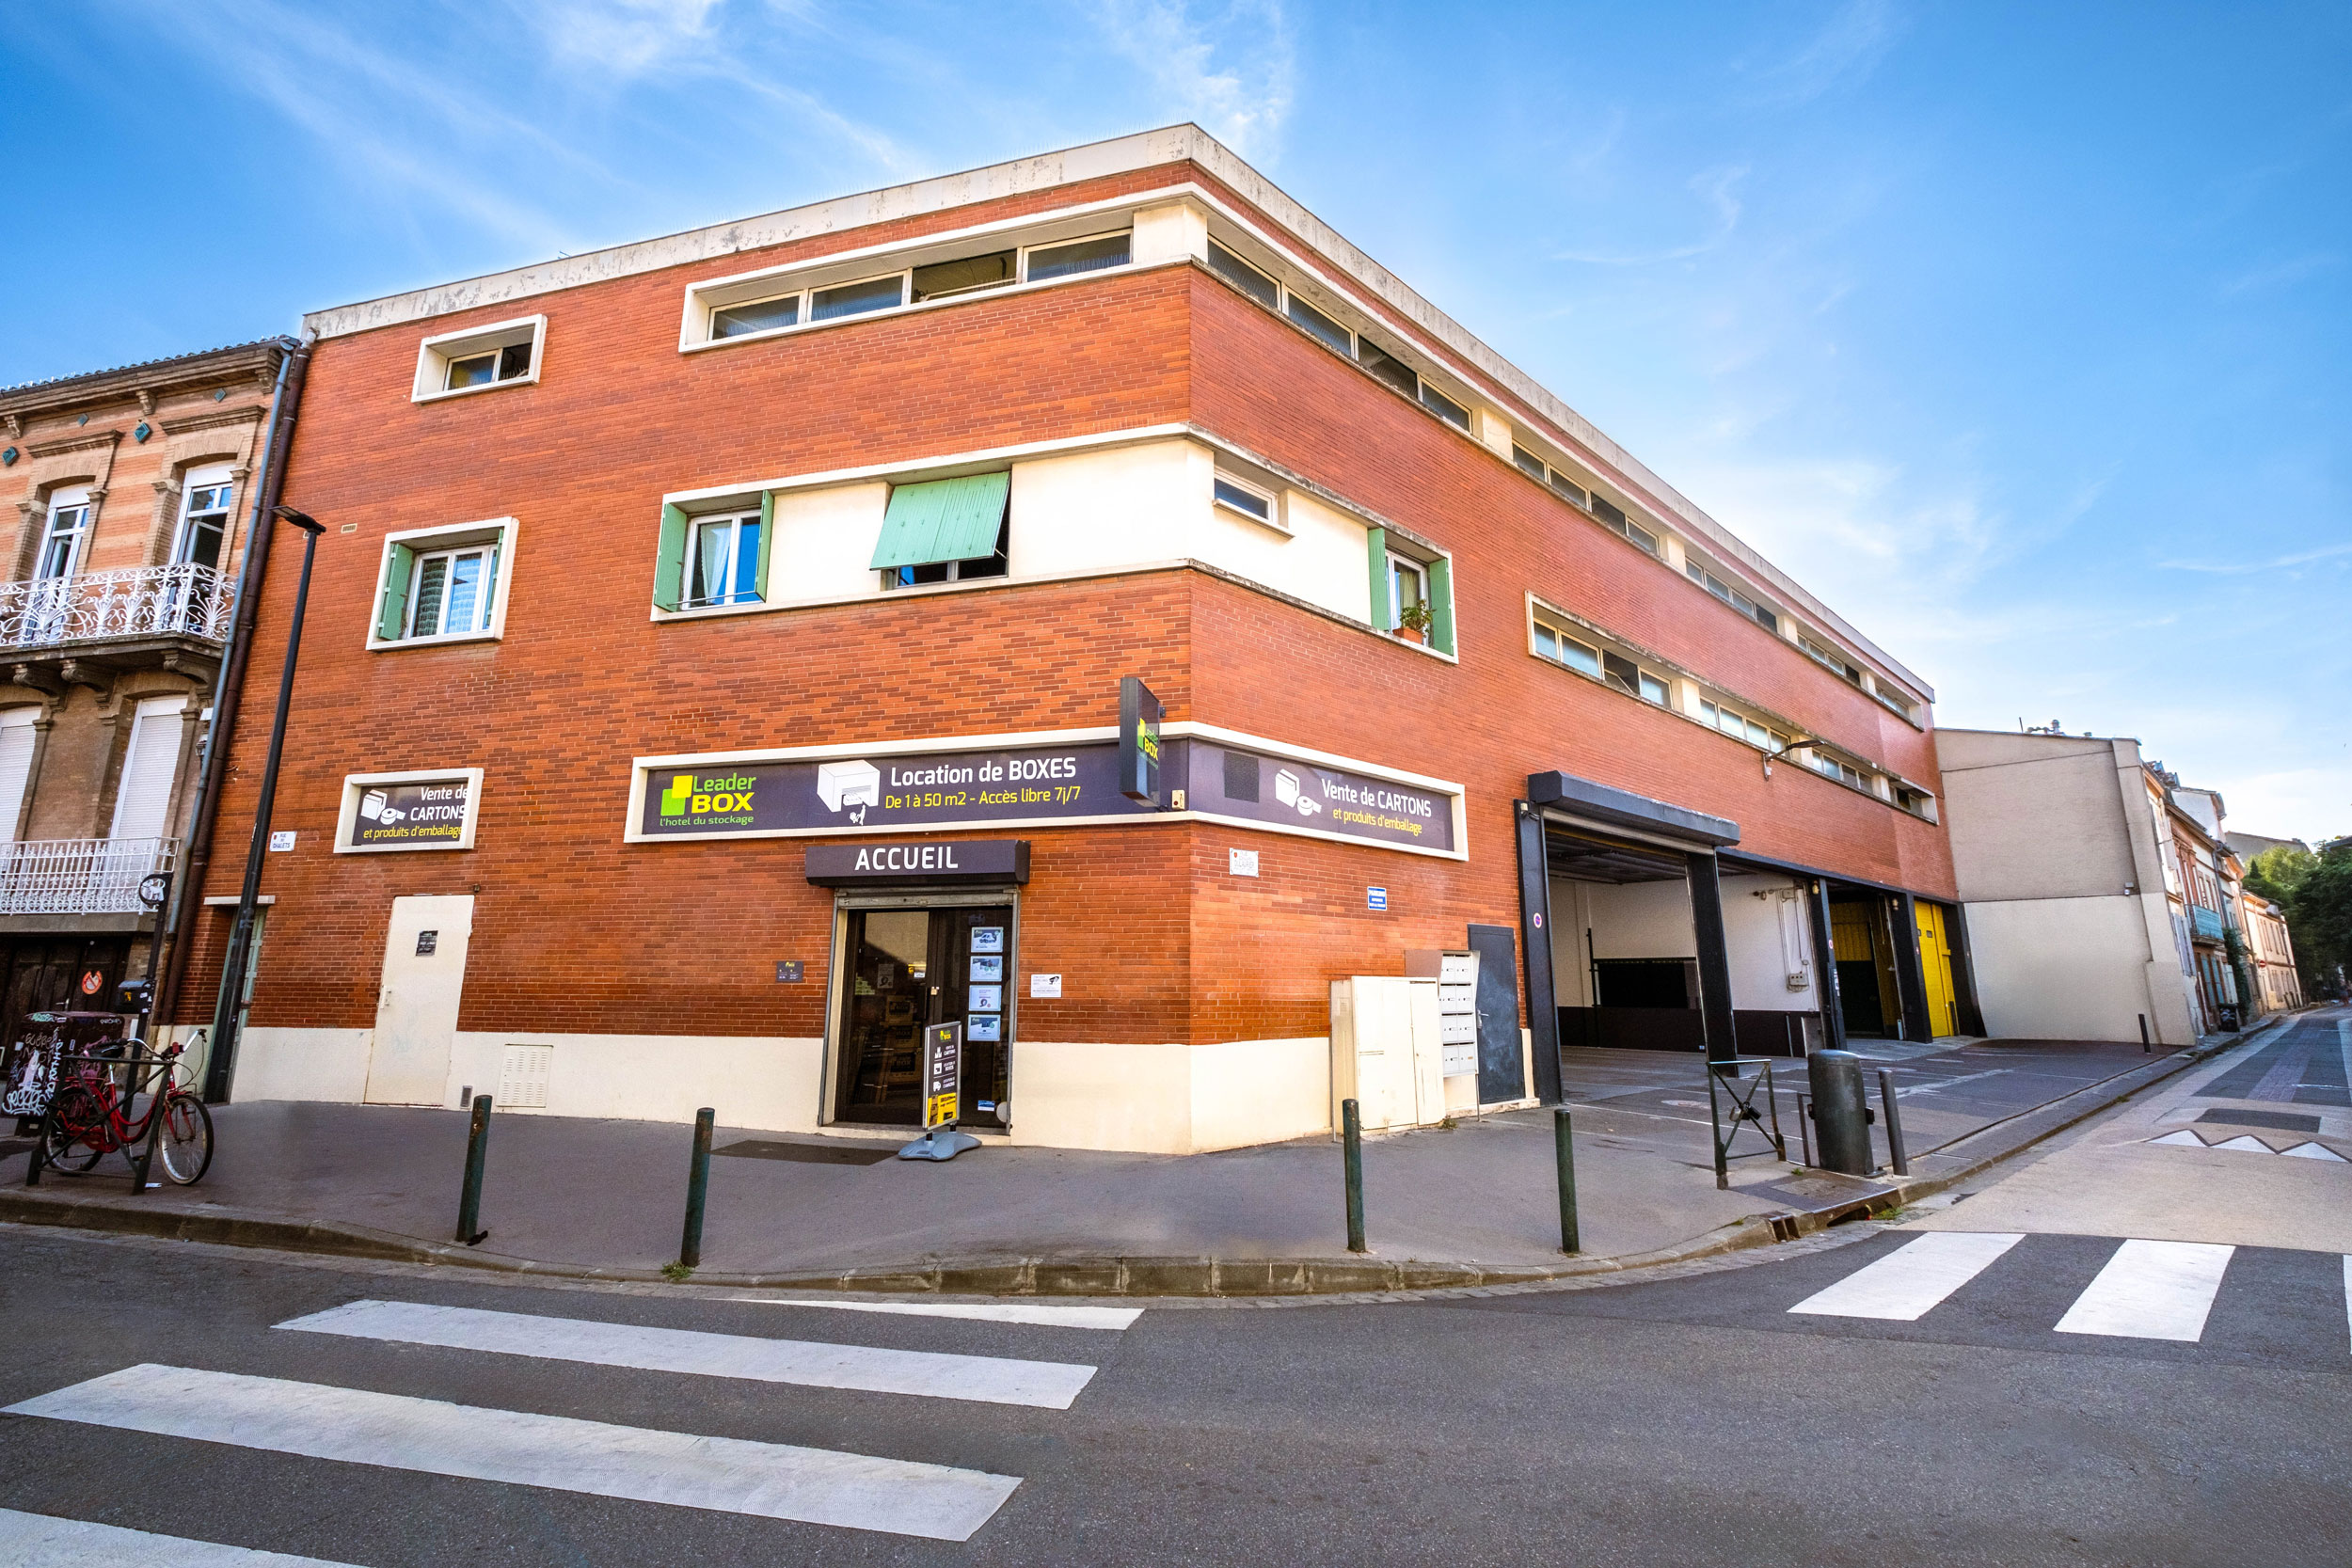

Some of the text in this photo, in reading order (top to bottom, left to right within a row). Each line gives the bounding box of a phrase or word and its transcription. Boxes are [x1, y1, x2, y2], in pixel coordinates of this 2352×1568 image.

[1144, 736, 1159, 762] BOX
[692, 772, 757, 793] Leader
[890, 756, 1076, 787] Location de BOXES
[421, 784, 469, 801] Vente de
[691, 791, 755, 814] BOX
[885, 795, 902, 809] De
[905, 795, 911, 808] 1
[914, 794, 921, 807] à
[924, 793, 942, 807] 50
[945, 791, 967, 806] m2
[978, 790, 1018, 805] Accès
[1021, 787, 1051, 802] libre
[1054, 785, 1082, 805] 7j/7
[1321, 778, 1432, 818] Vente de CARTONS
[410, 804, 466, 821] CARTONS
[660, 815, 755, 827] l'hotel du stockage
[1332, 807, 1422, 836] et produits d'emballage
[363, 828, 373, 839] et
[373, 827, 409, 842] produits
[854, 846, 959, 871] ACCUEIL
